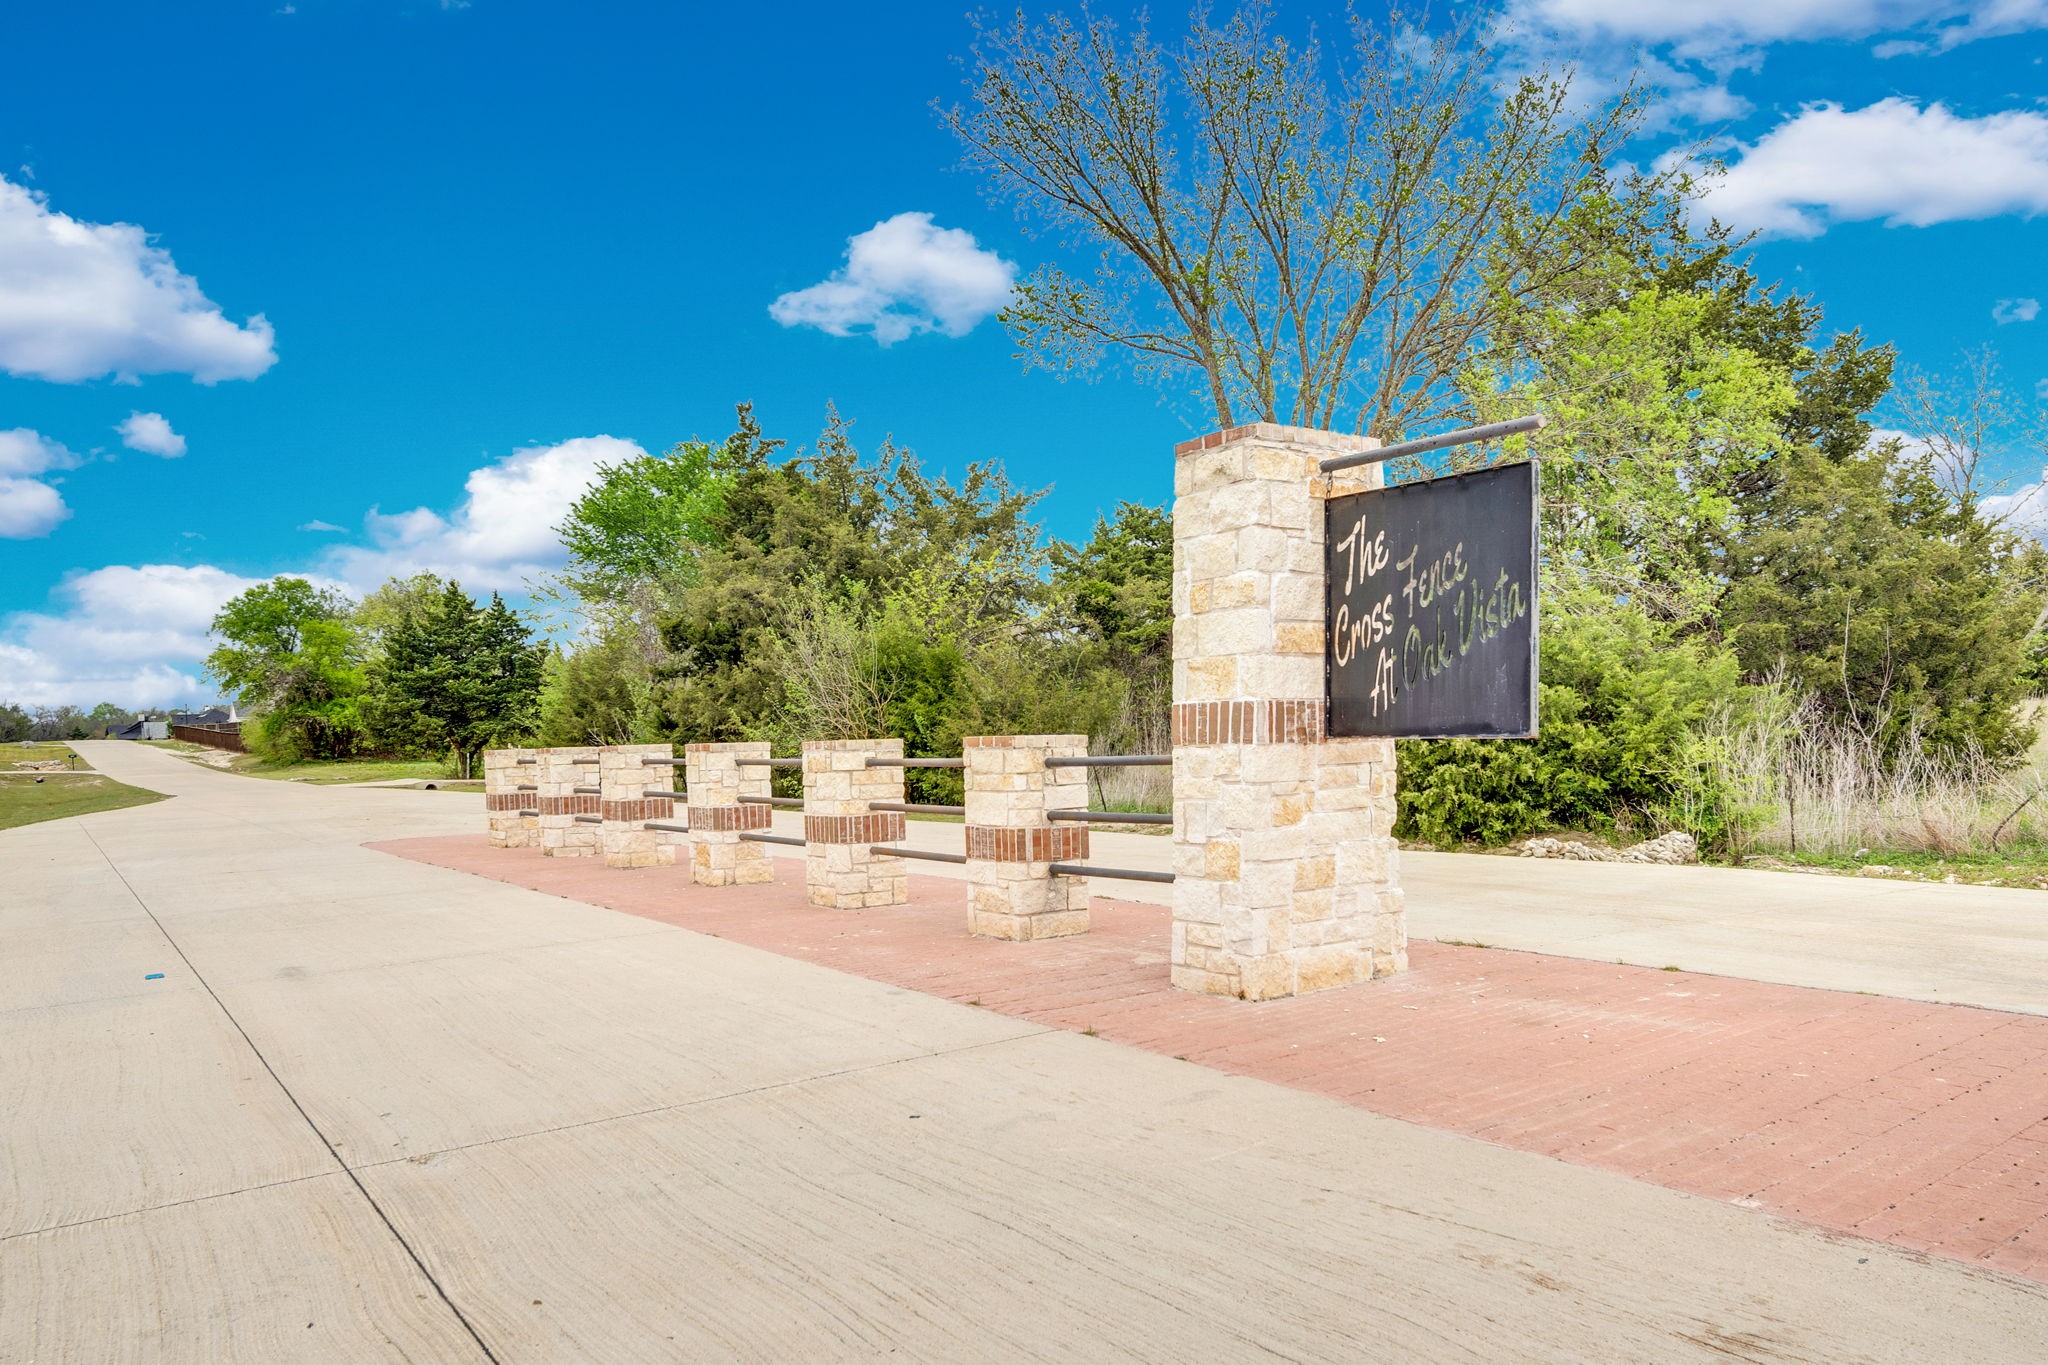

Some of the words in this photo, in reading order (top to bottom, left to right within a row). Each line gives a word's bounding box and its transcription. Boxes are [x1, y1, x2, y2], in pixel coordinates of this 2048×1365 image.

[1334, 594, 1394, 667] Cross
[1396, 542, 1467, 618] Fence
[1337, 514, 1389, 596] The
[1370, 647, 1398, 717] At
[1402, 605, 1453, 692] Oak
[1453, 567, 1526, 656] Vista
